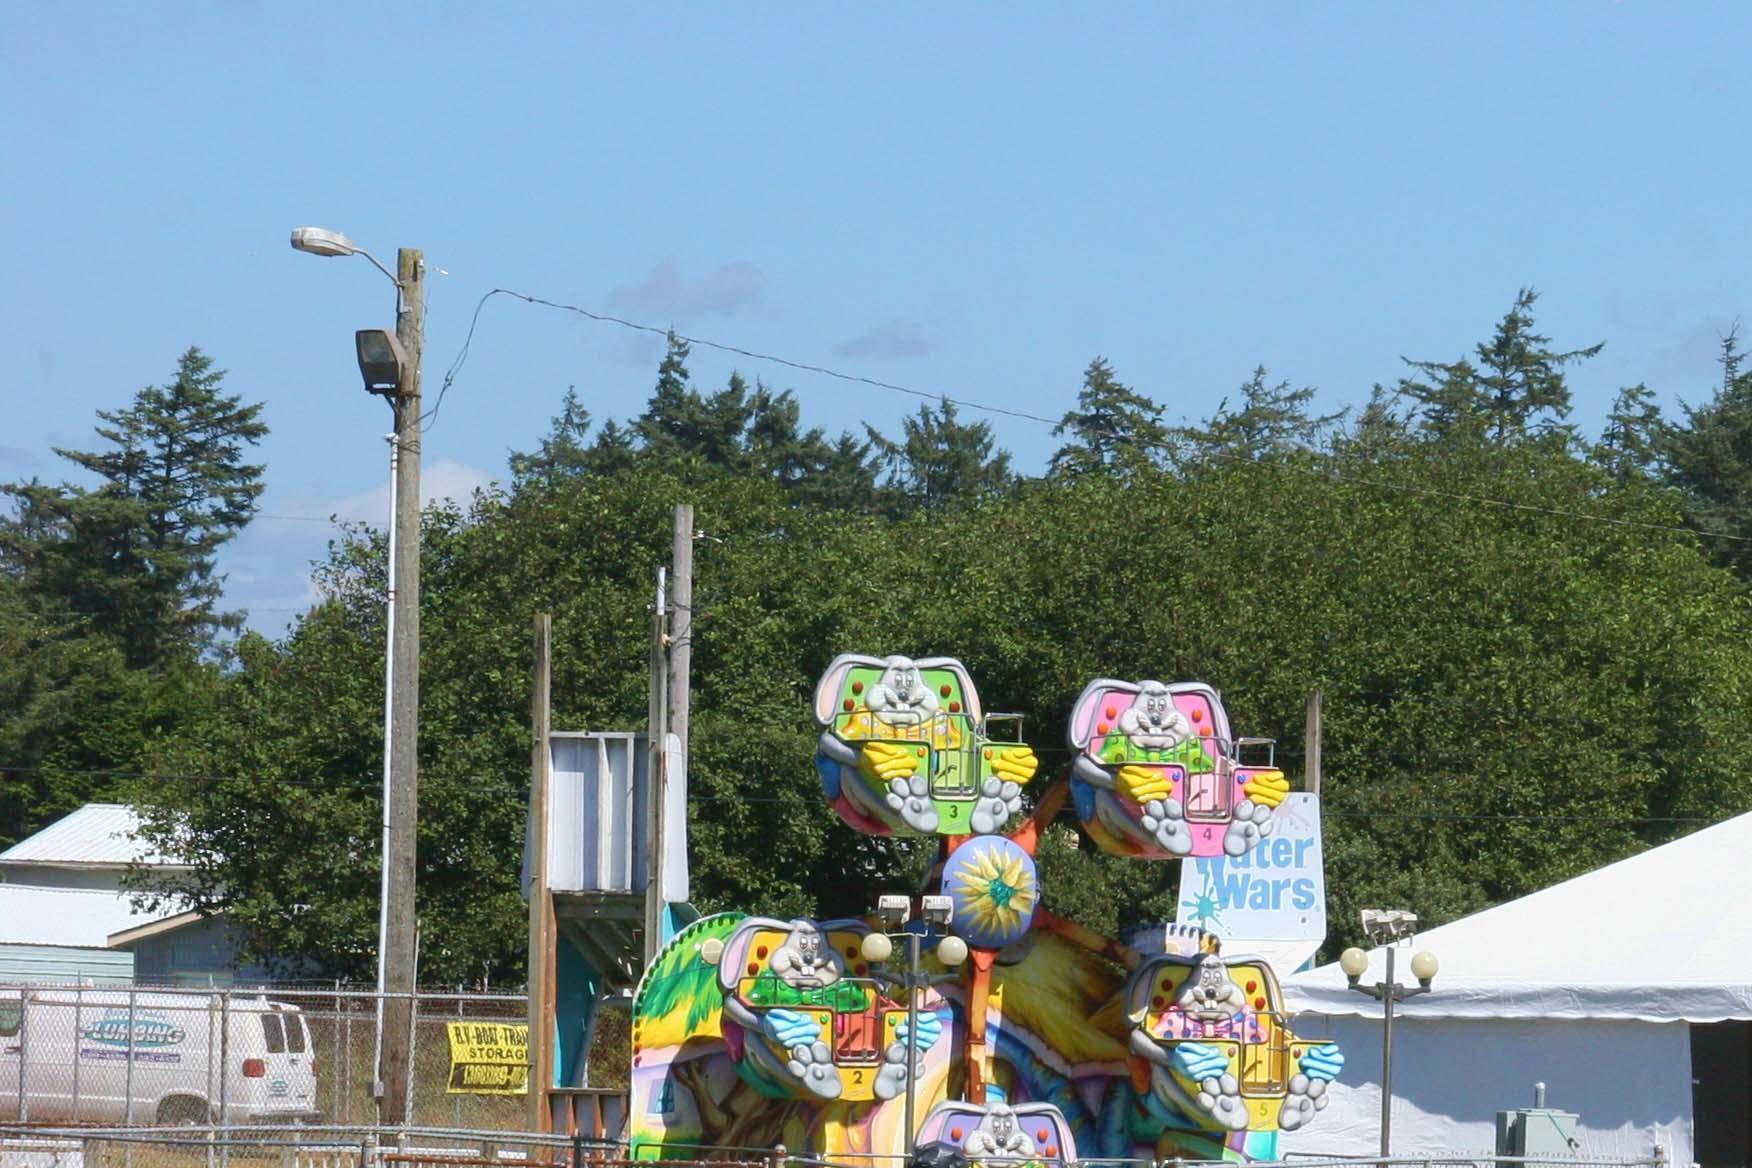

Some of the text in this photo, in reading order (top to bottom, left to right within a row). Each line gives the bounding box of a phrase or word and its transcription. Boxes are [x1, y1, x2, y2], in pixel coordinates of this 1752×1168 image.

[949, 804, 959, 819] 3
[1202, 827, 1212, 841] 4
[1214, 873, 1315, 910] Wars
[469, 1047, 528, 1060] STORAG
[853, 1070, 863, 1085] 2
[1258, 1103, 1269, 1117] 5
